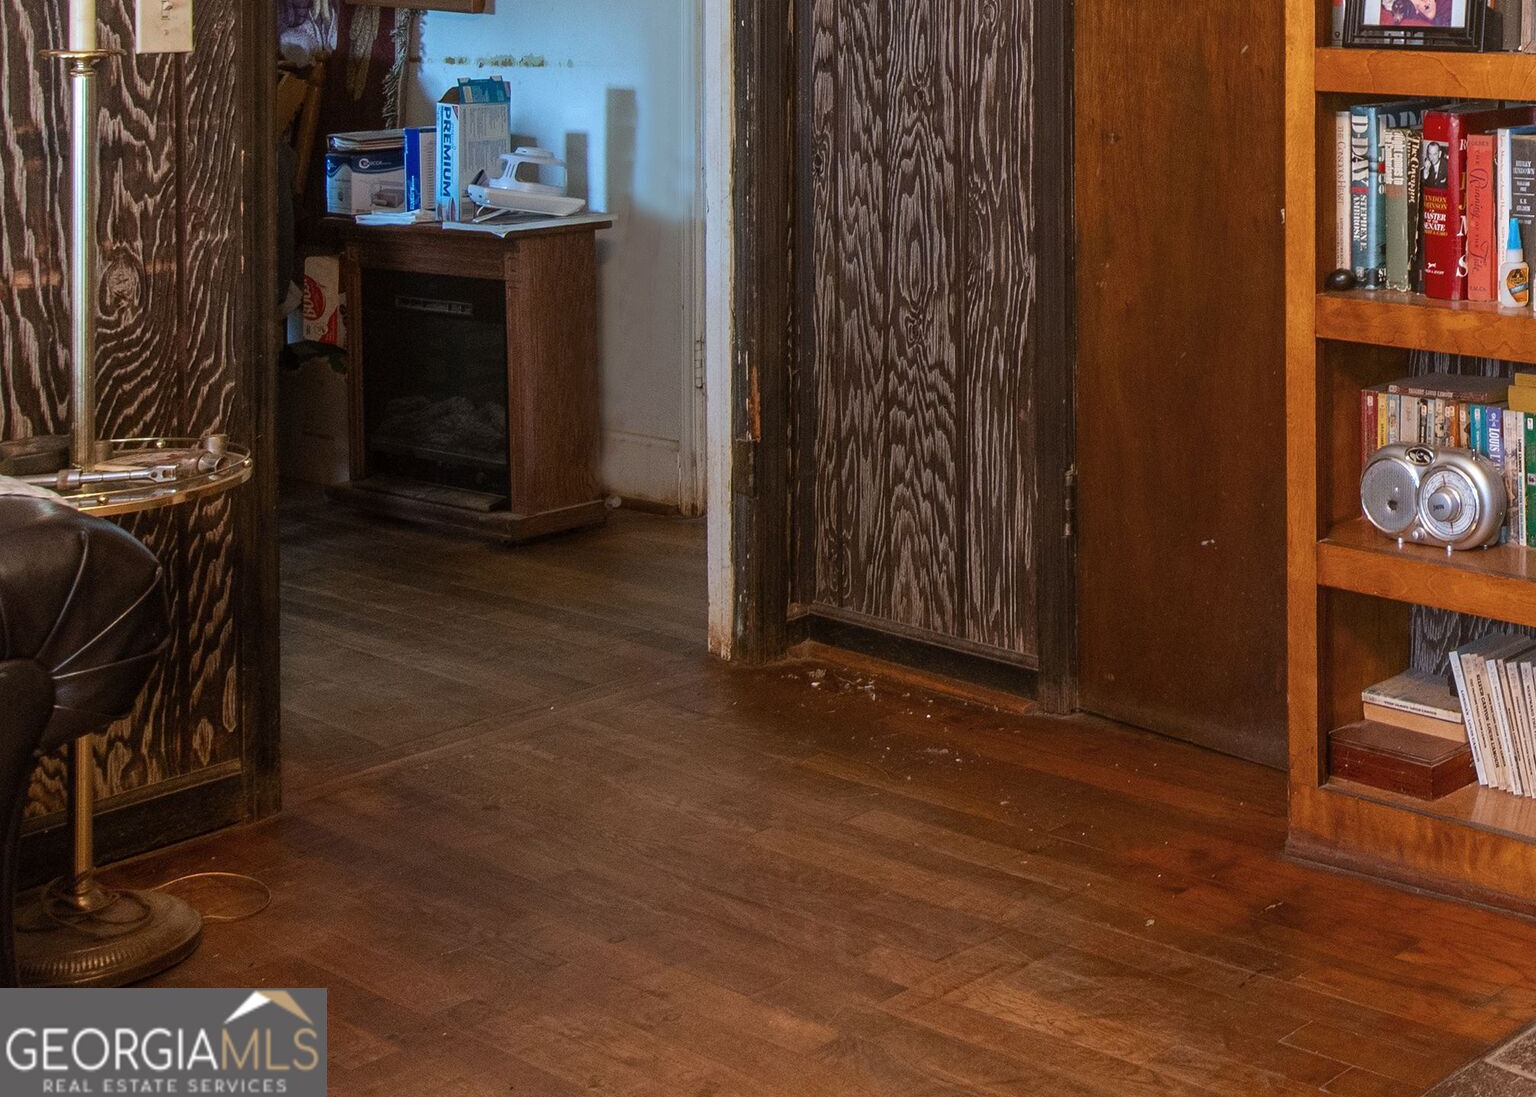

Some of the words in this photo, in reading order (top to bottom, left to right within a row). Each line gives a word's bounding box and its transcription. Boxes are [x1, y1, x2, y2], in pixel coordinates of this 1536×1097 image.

[443, 106, 451, 197] PREMIUM
[1337, 141, 1346, 179] CONSCIOUS
[1351, 115, 1369, 186] D-DAY
[1337, 181, 1346, 205] HEART
[1470, 168, 1489, 219] Running
[1360, 194, 1368, 240] STEPHEN
[1360, 242, 1367, 251] E.
[1489, 428, 1500, 452] LOUIS
[1480, 698, 1489, 721] CANYON
[1486, 723, 1494, 741] LOUIS
[1490, 742, 1499, 768] L'AMOUR
